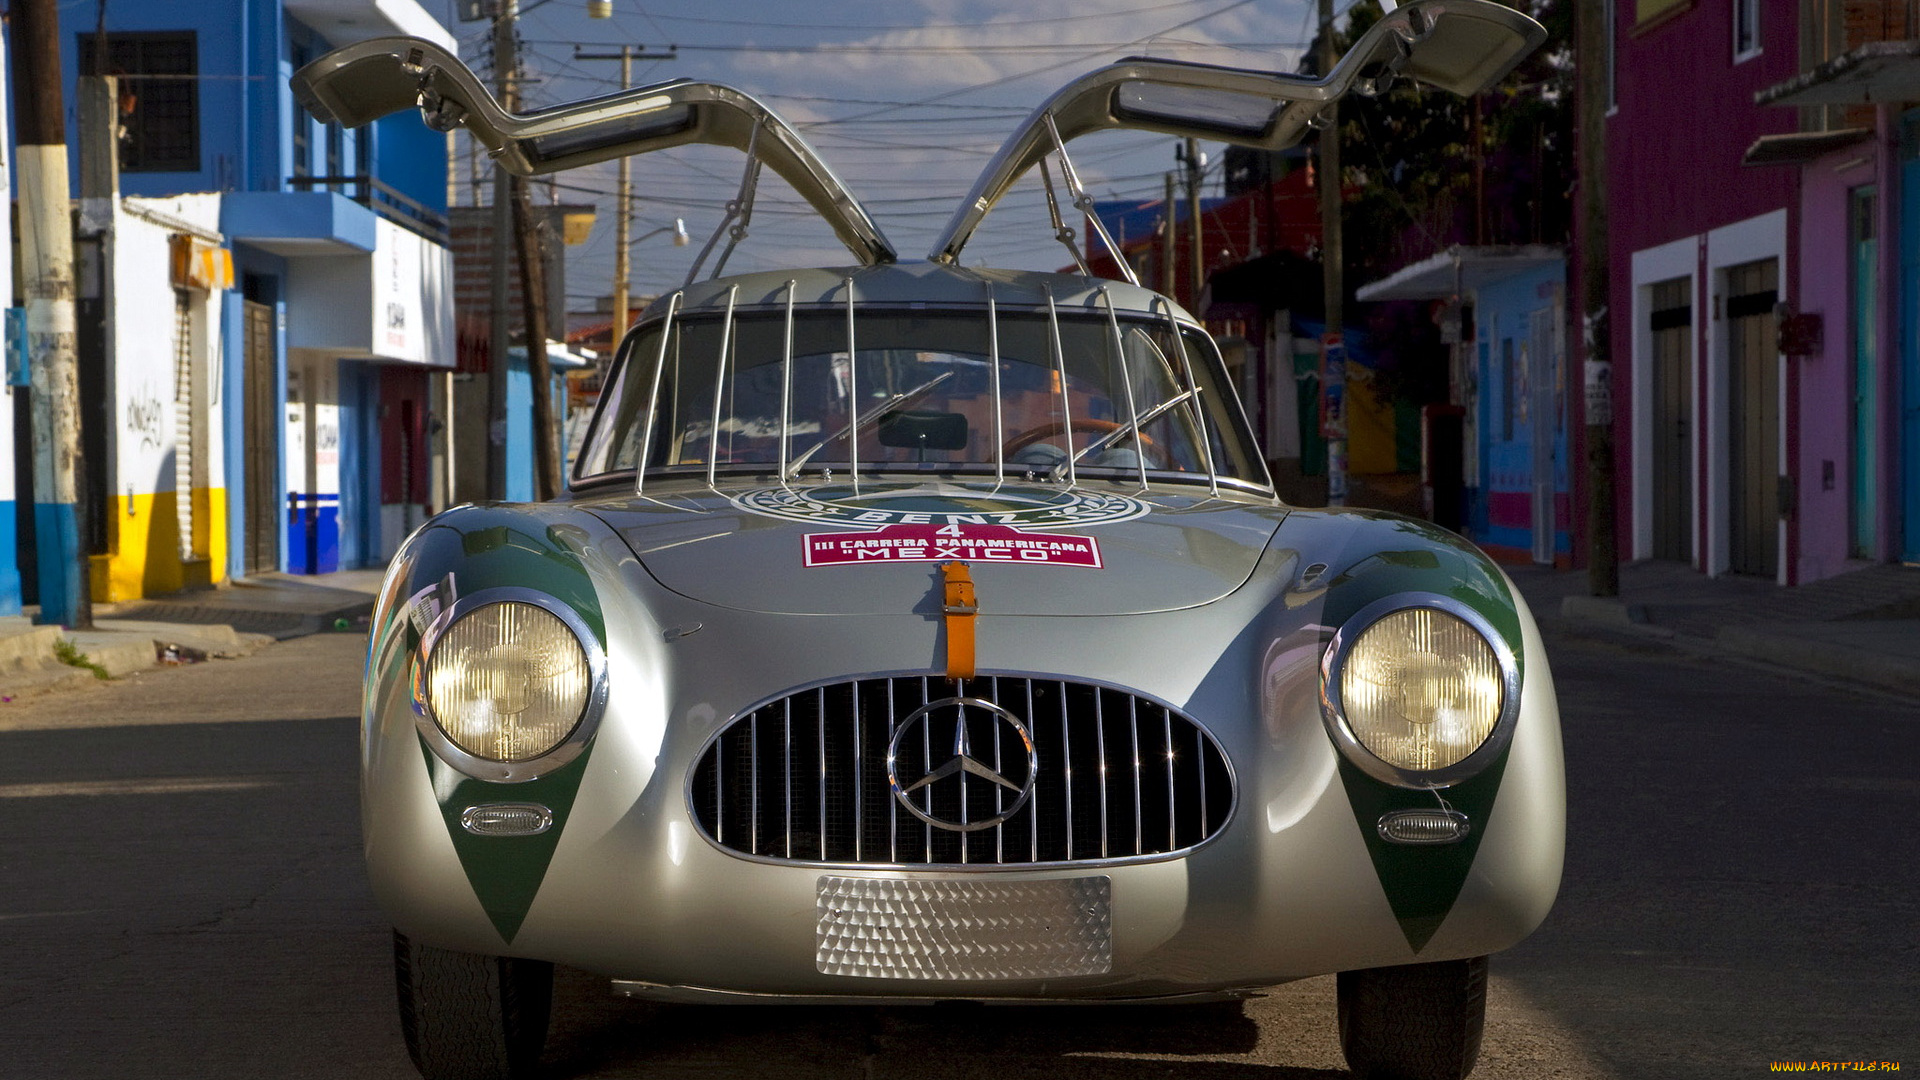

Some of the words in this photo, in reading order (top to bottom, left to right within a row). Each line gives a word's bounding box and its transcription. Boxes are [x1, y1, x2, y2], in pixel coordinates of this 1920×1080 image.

[853, 511, 1031, 525] BENZ
[935, 523, 965, 538] 4
[814, 541, 834, 550] III
[840, 538, 929, 549] CARRERA
[936, 538, 1089, 553] PANAMERICANA
